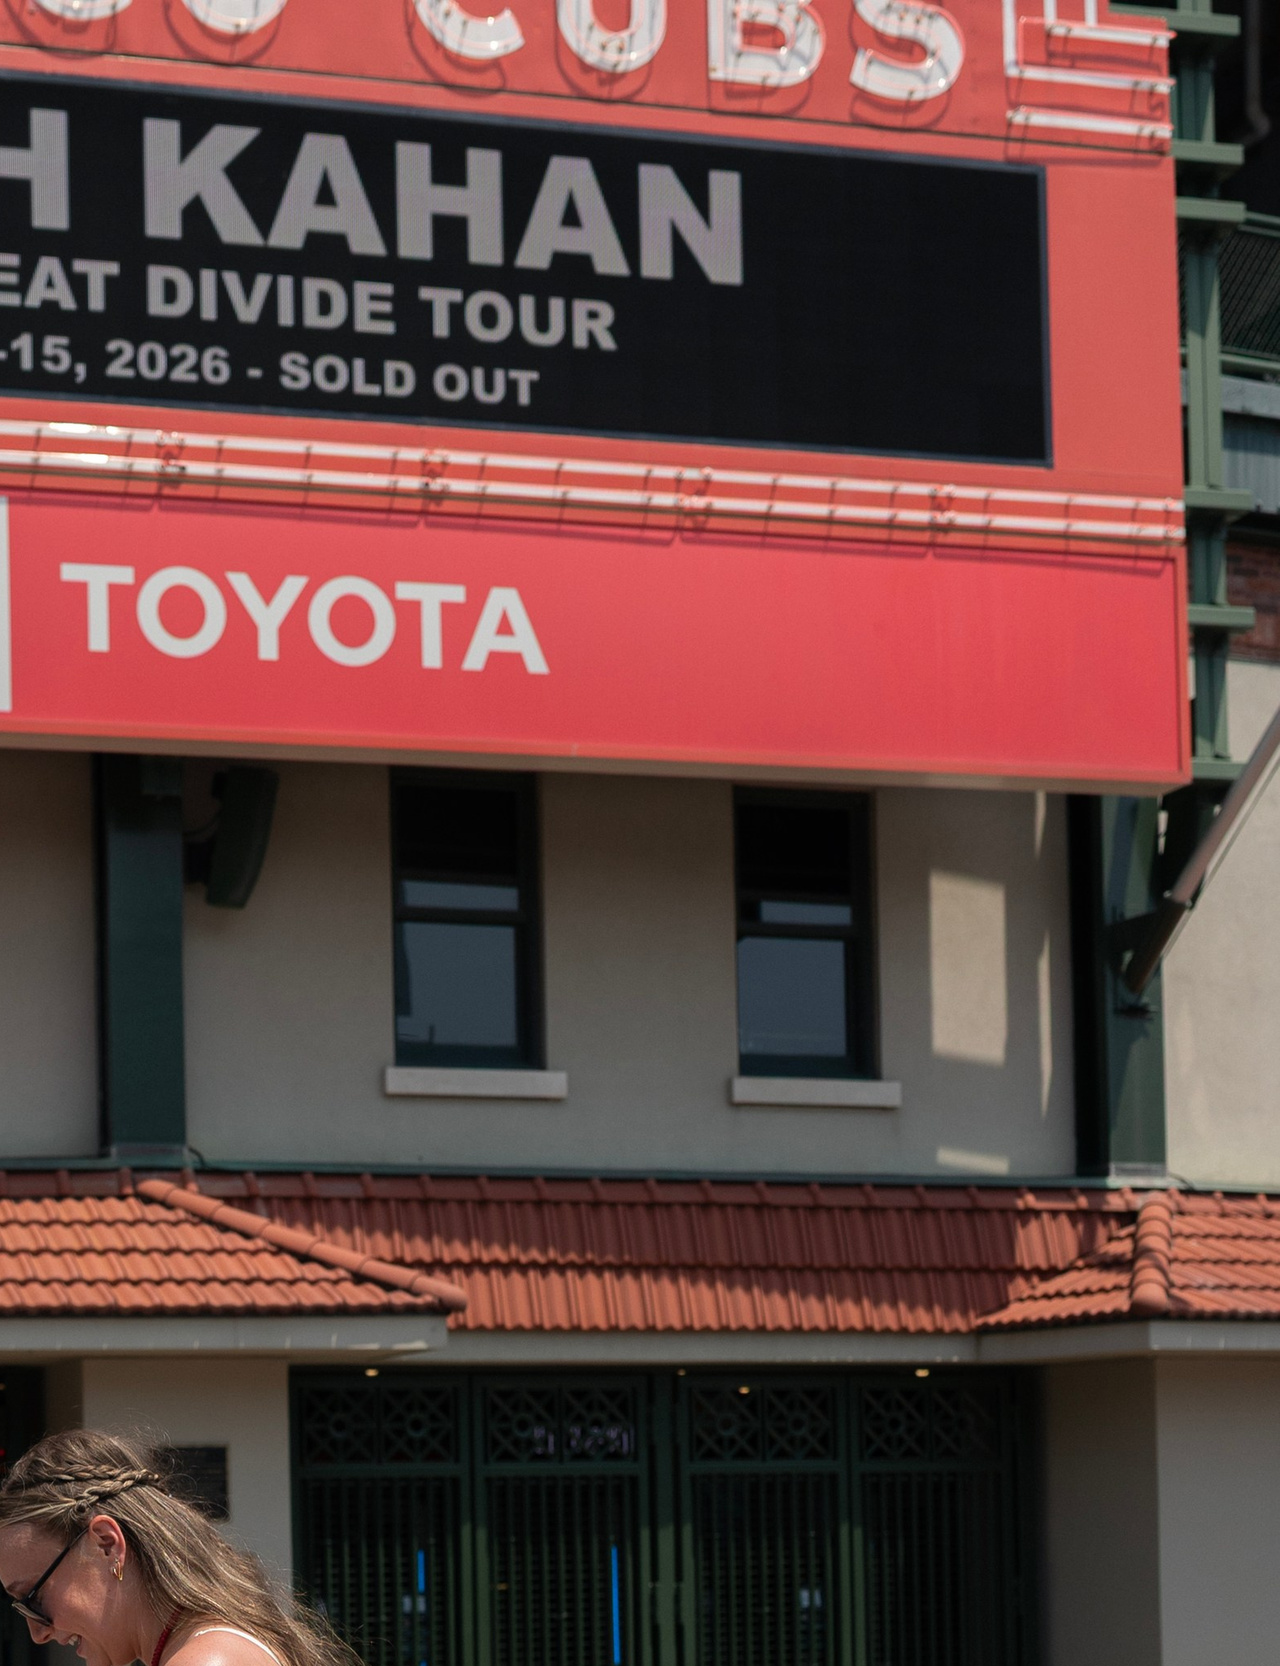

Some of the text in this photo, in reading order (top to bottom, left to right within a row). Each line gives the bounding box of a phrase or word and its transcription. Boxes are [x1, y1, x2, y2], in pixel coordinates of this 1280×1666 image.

[144, 119, 741, 284] KAHAN
[148, 265, 394, 334] DIVIDE
[419, 287, 615, 350] TOUR
[106, 339, 229, 384] 2026
[281, 352, 415, 397] SOLD
[434, 364, 538, 405] OUT
[61, 563, 548, 674] TOYOTA
